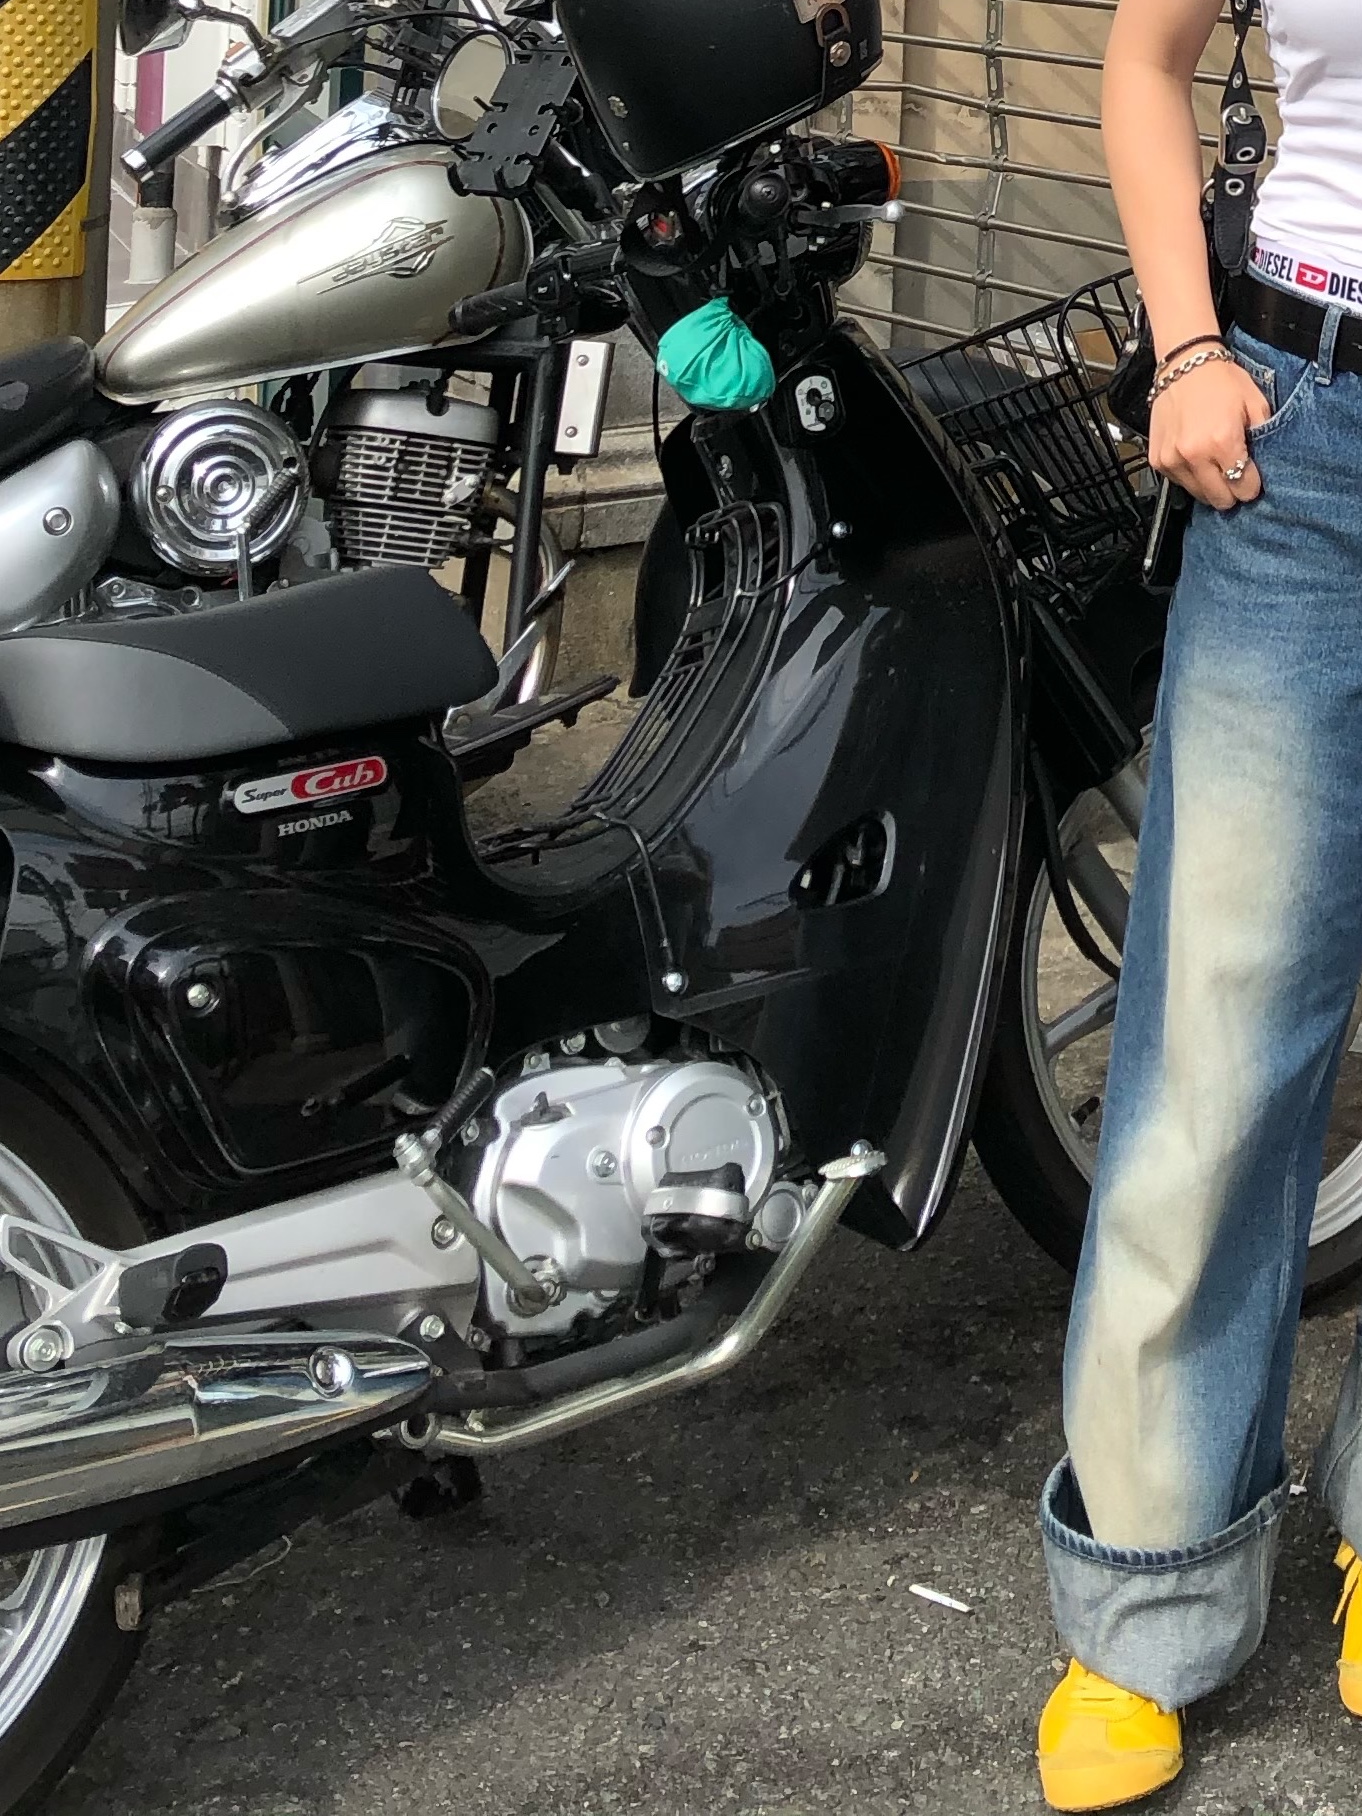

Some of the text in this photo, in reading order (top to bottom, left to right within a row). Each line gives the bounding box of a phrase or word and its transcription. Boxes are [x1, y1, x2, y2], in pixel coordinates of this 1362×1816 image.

[1259, 249, 1294, 282] DIESEL
[241, 763, 375, 804] Super Cub
[277, 809, 354, 838] HONDA
